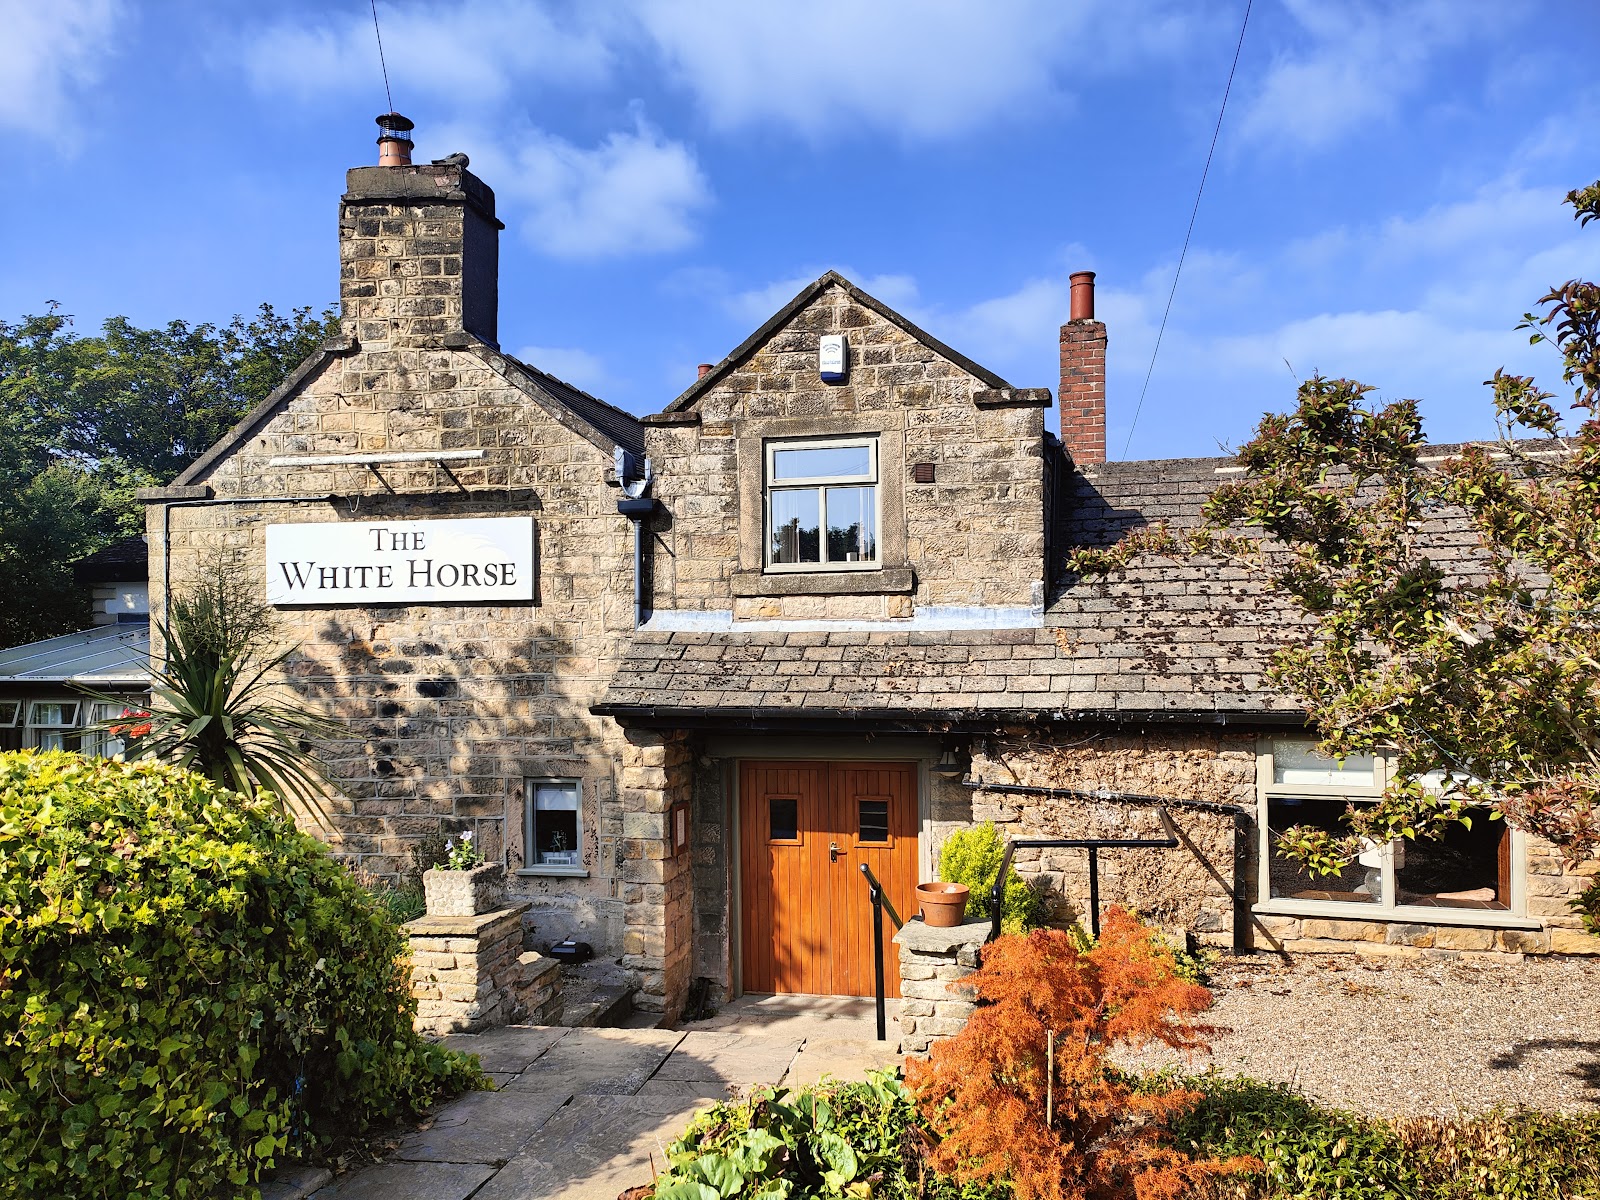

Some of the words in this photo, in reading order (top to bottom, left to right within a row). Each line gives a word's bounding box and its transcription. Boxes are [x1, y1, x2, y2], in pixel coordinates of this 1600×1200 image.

[369, 528, 426, 551] THE
[279, 561, 394, 590] WHITE
[406, 559, 517, 588] HORSE
